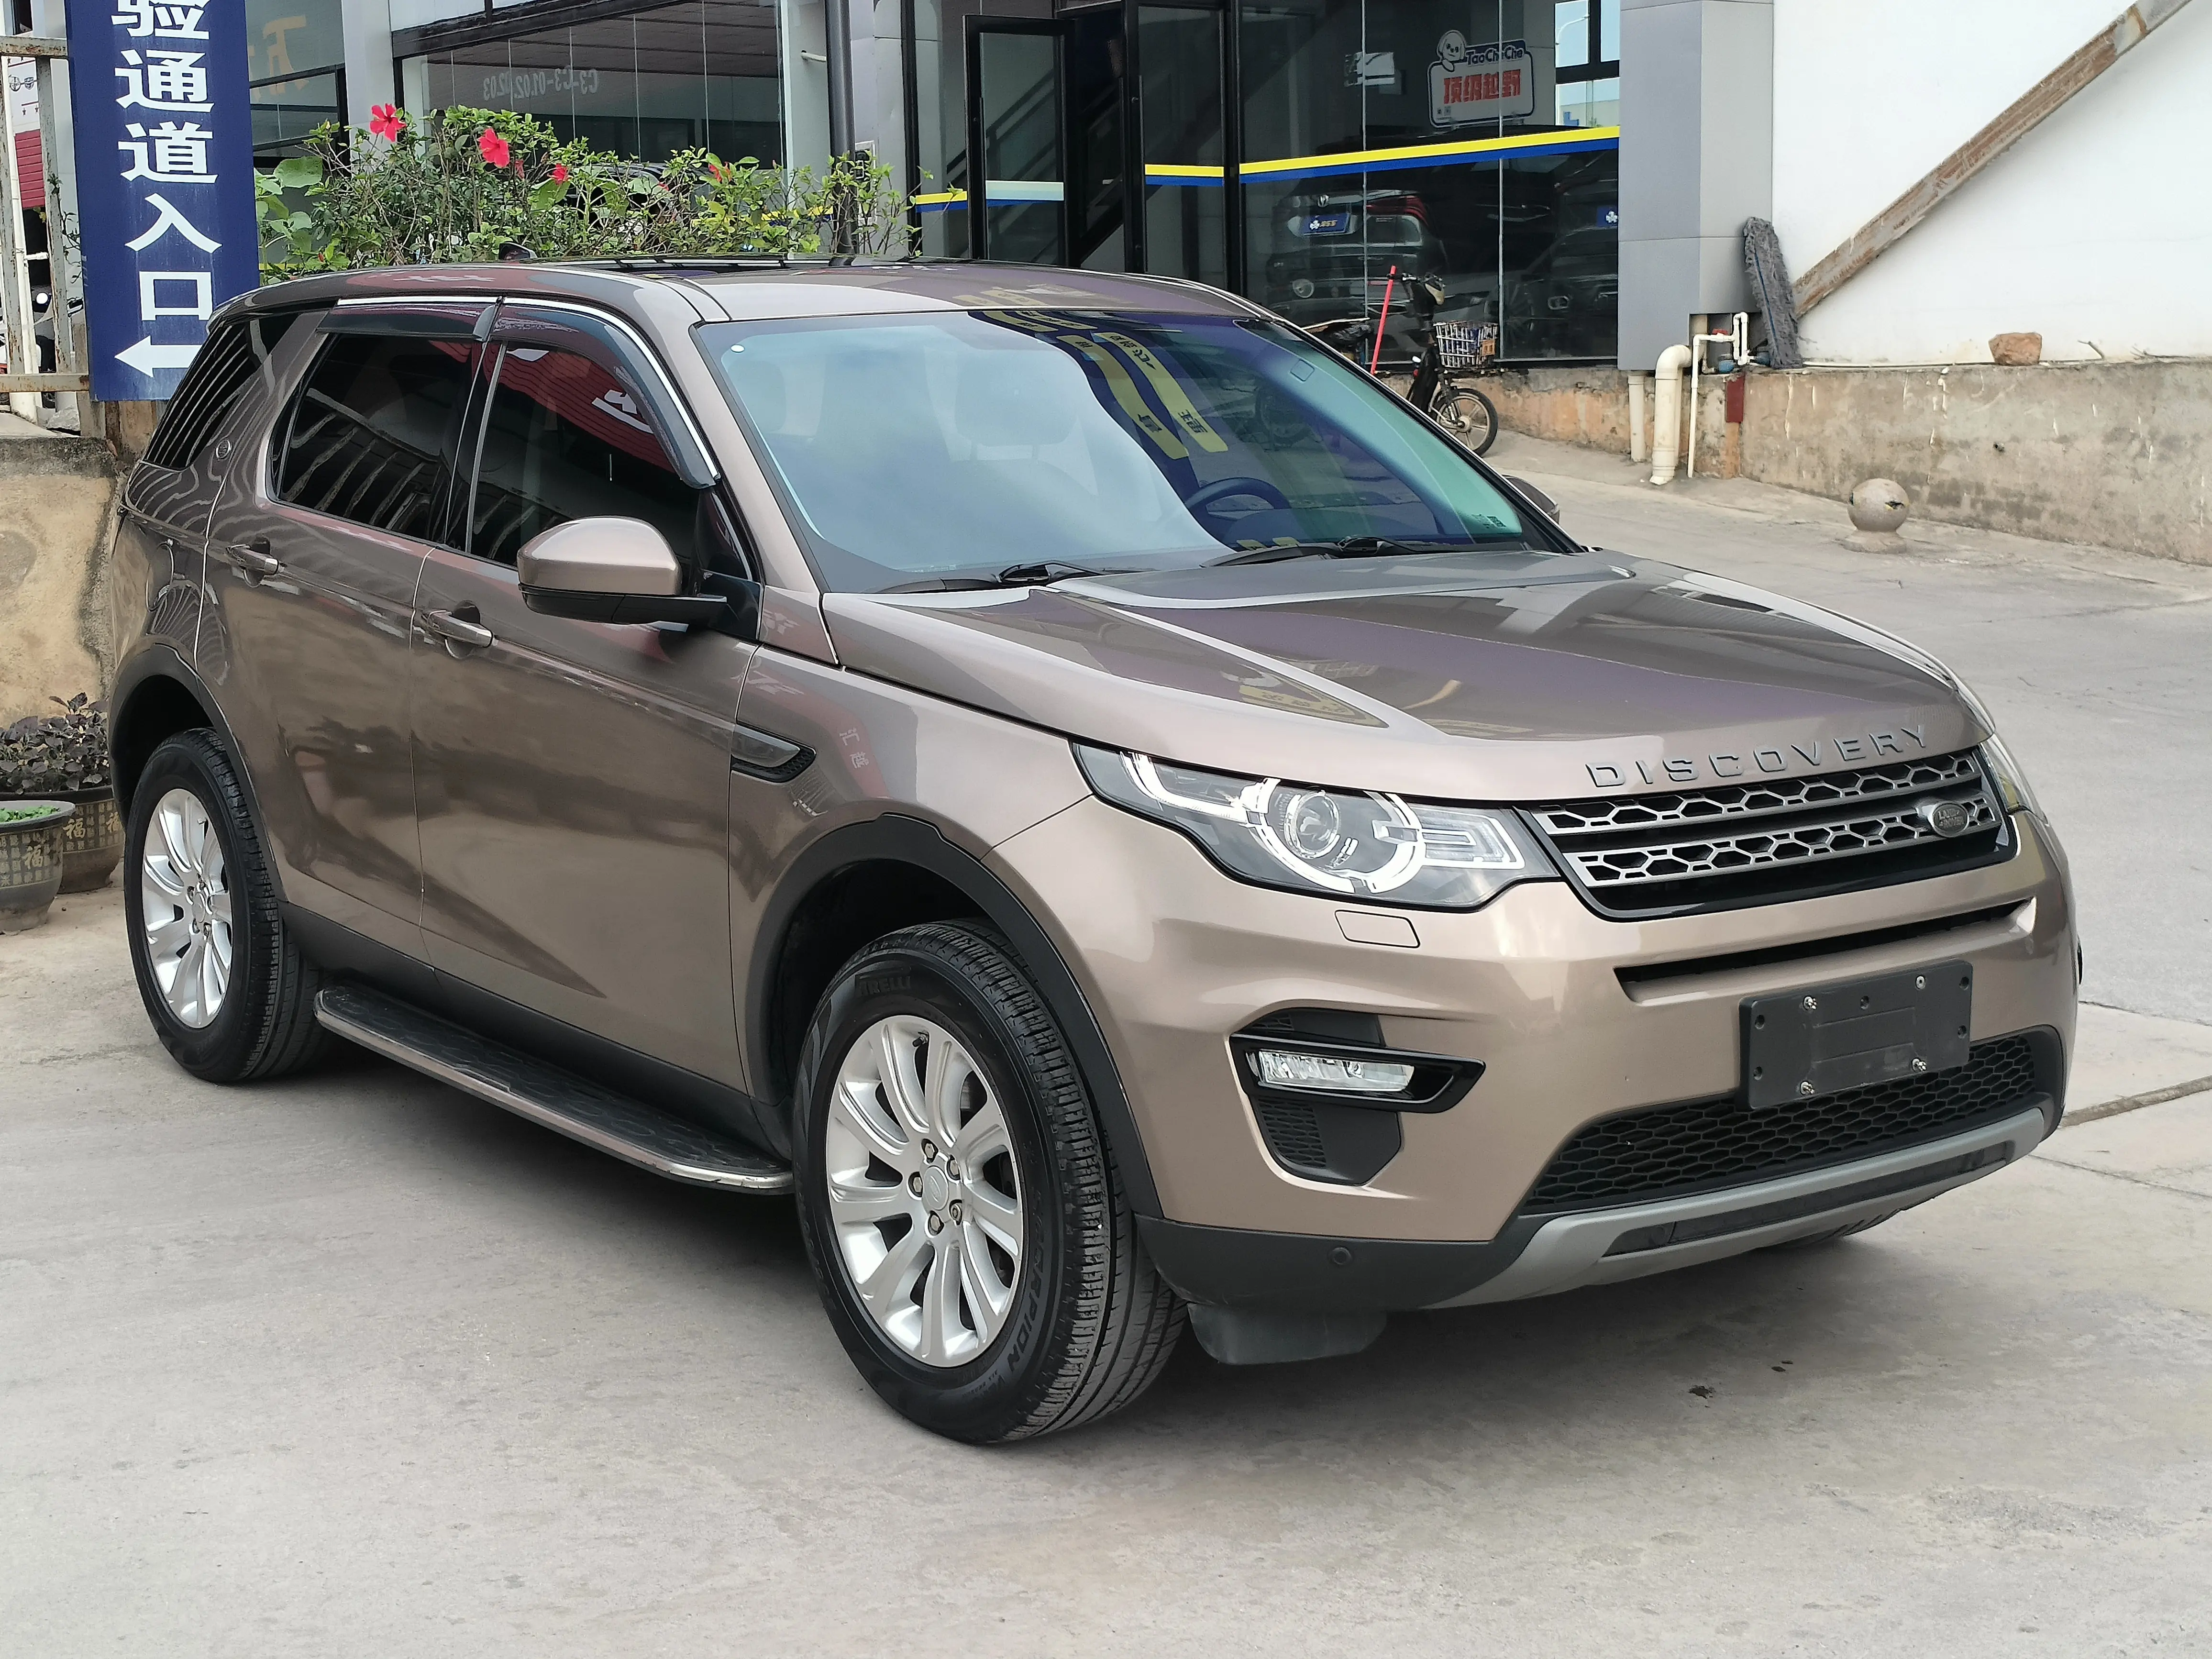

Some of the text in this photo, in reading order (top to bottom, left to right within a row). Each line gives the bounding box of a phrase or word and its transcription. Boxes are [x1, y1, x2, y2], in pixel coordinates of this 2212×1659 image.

[111, 0, 223, 321] 验通道入口
[1585, 724, 1926, 787] DISCOVERY
[62, 818, 86, 839] 福
